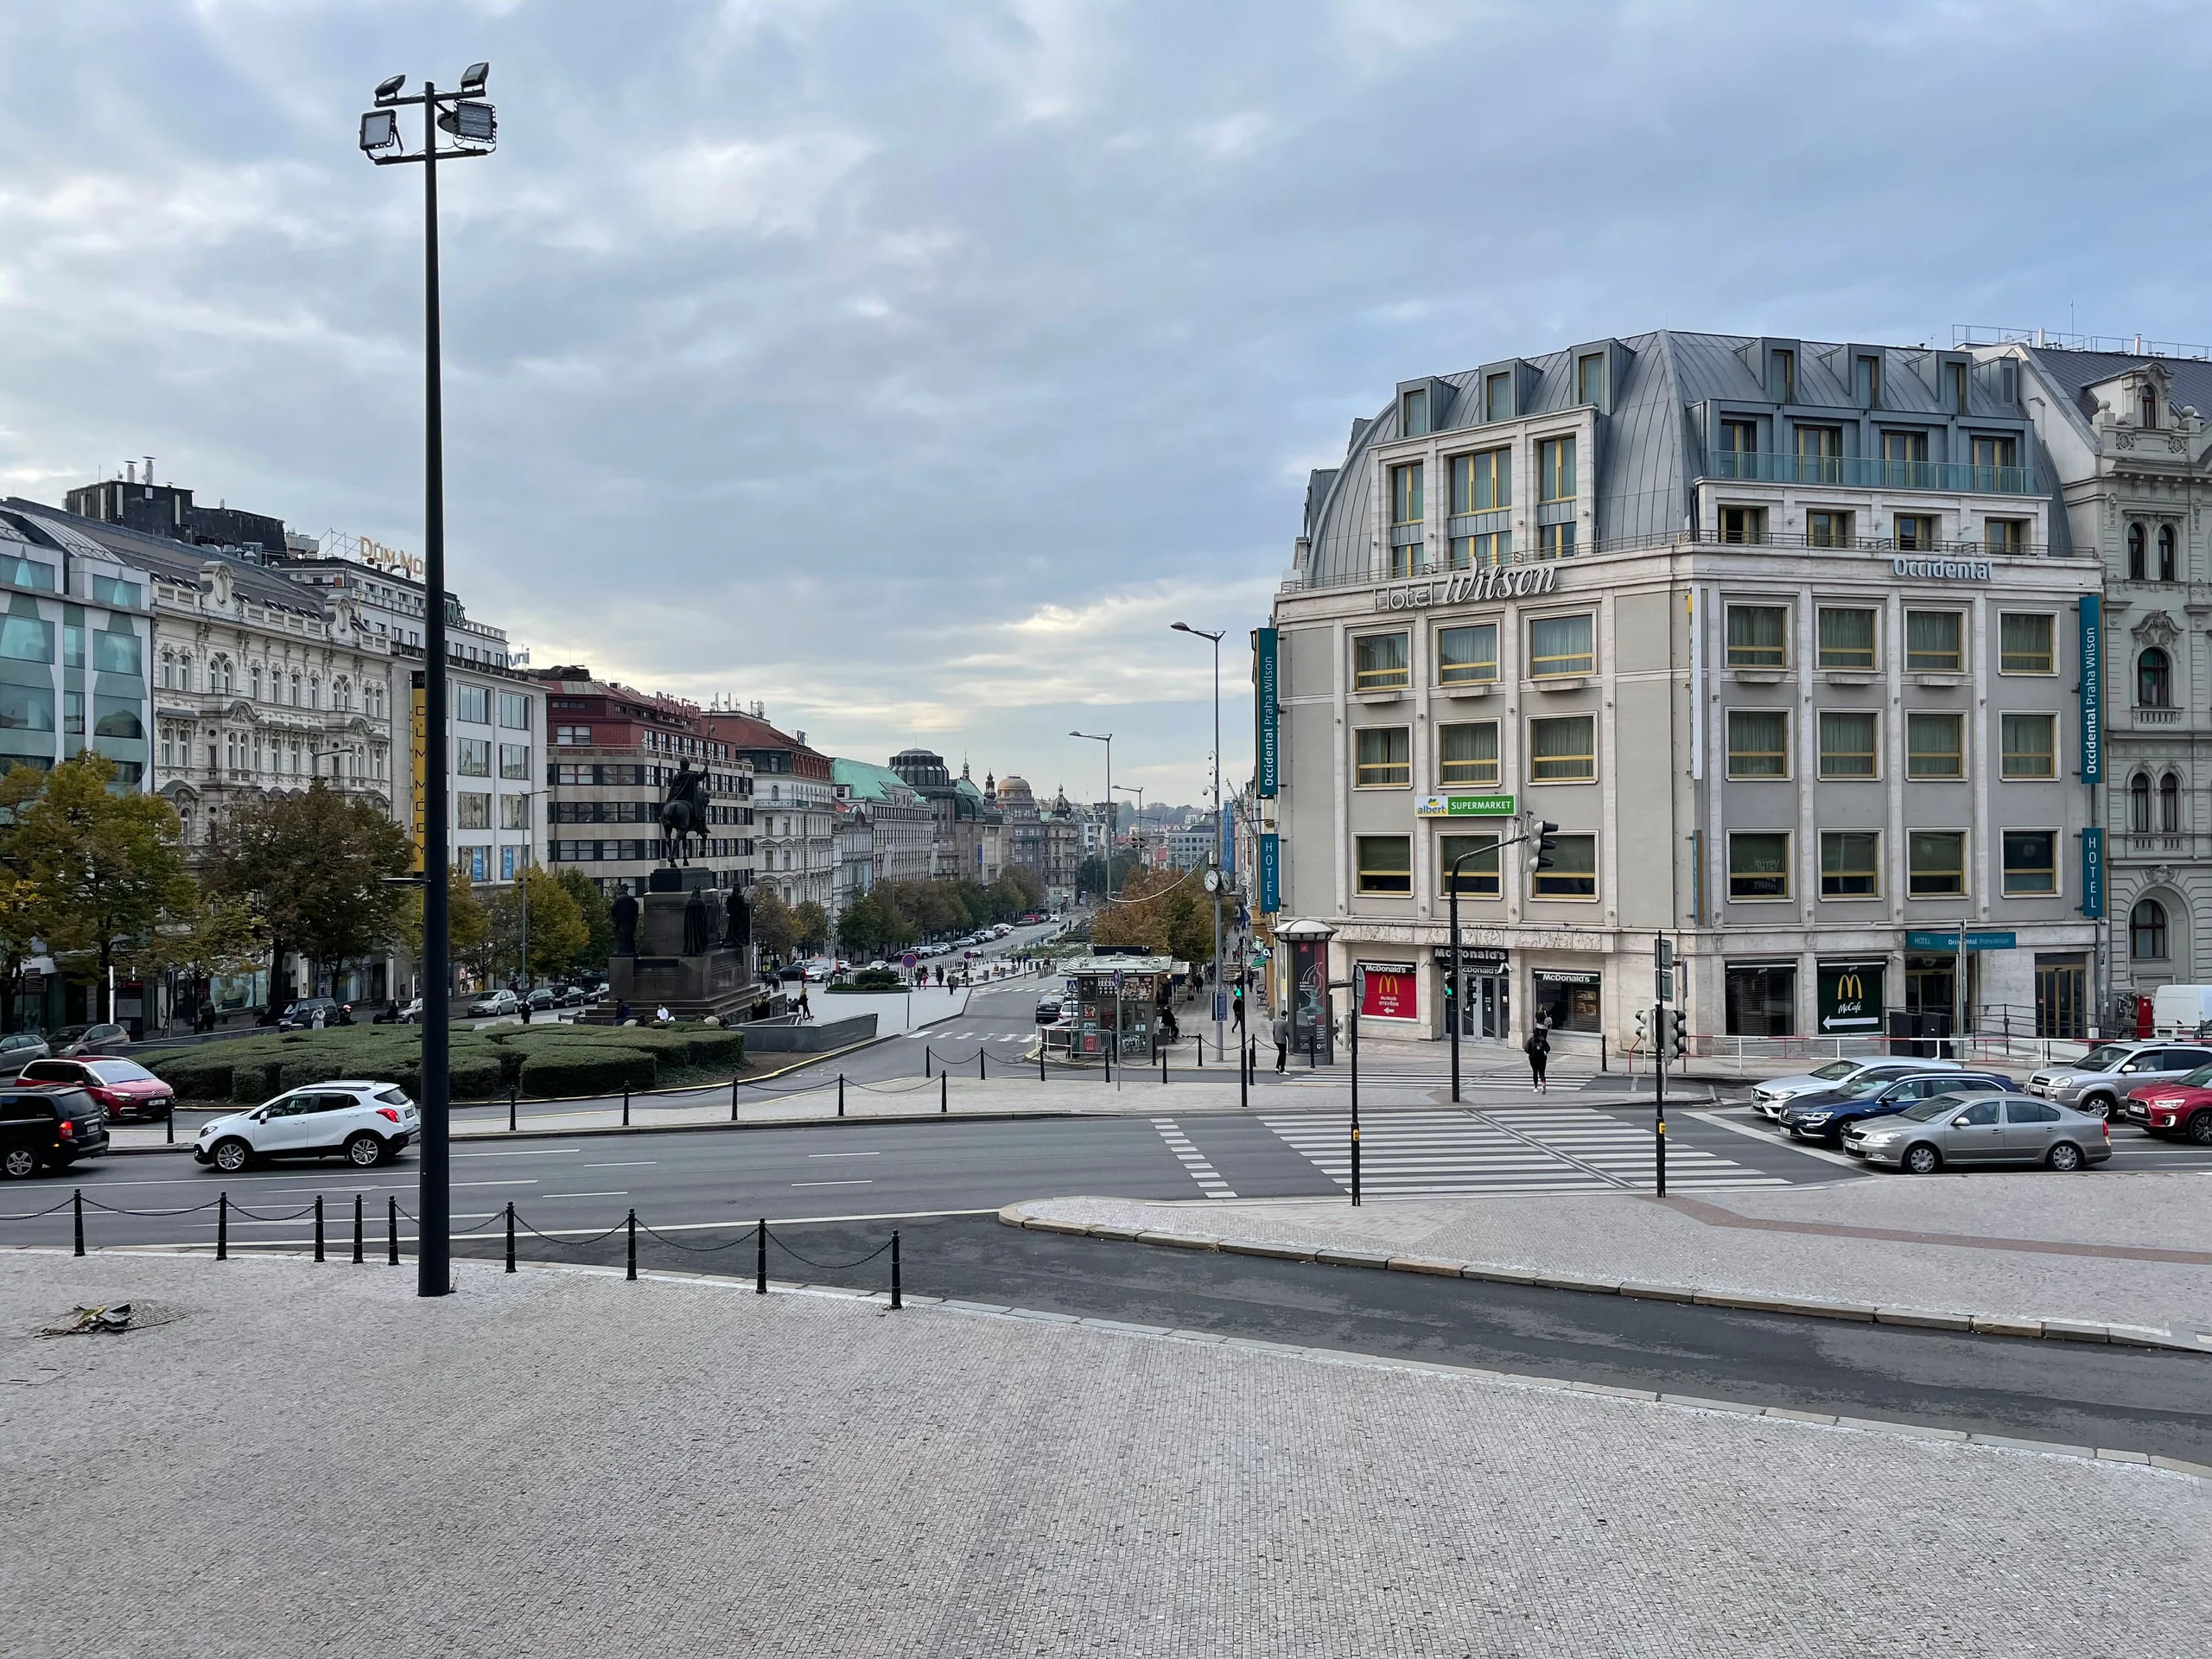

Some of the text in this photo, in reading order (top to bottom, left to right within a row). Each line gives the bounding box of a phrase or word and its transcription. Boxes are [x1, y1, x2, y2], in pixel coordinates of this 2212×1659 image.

[1893, 558, 1993, 581] Occidental
[1373, 556, 1556, 612] Hotel Wilson
[2085, 627, 2096, 774] Occidental Praha Wilson
[1264, 656, 1274, 786] Occidental Praha Wilson
[1417, 801, 1511, 814] albert SUPERMARKET
[1914, 937, 1931, 945] HOTEL
[1434, 949, 1506, 960] Mconald's
[1365, 965, 1406, 974] McDonald's
[1542, 973, 1590, 982] McDonald's
